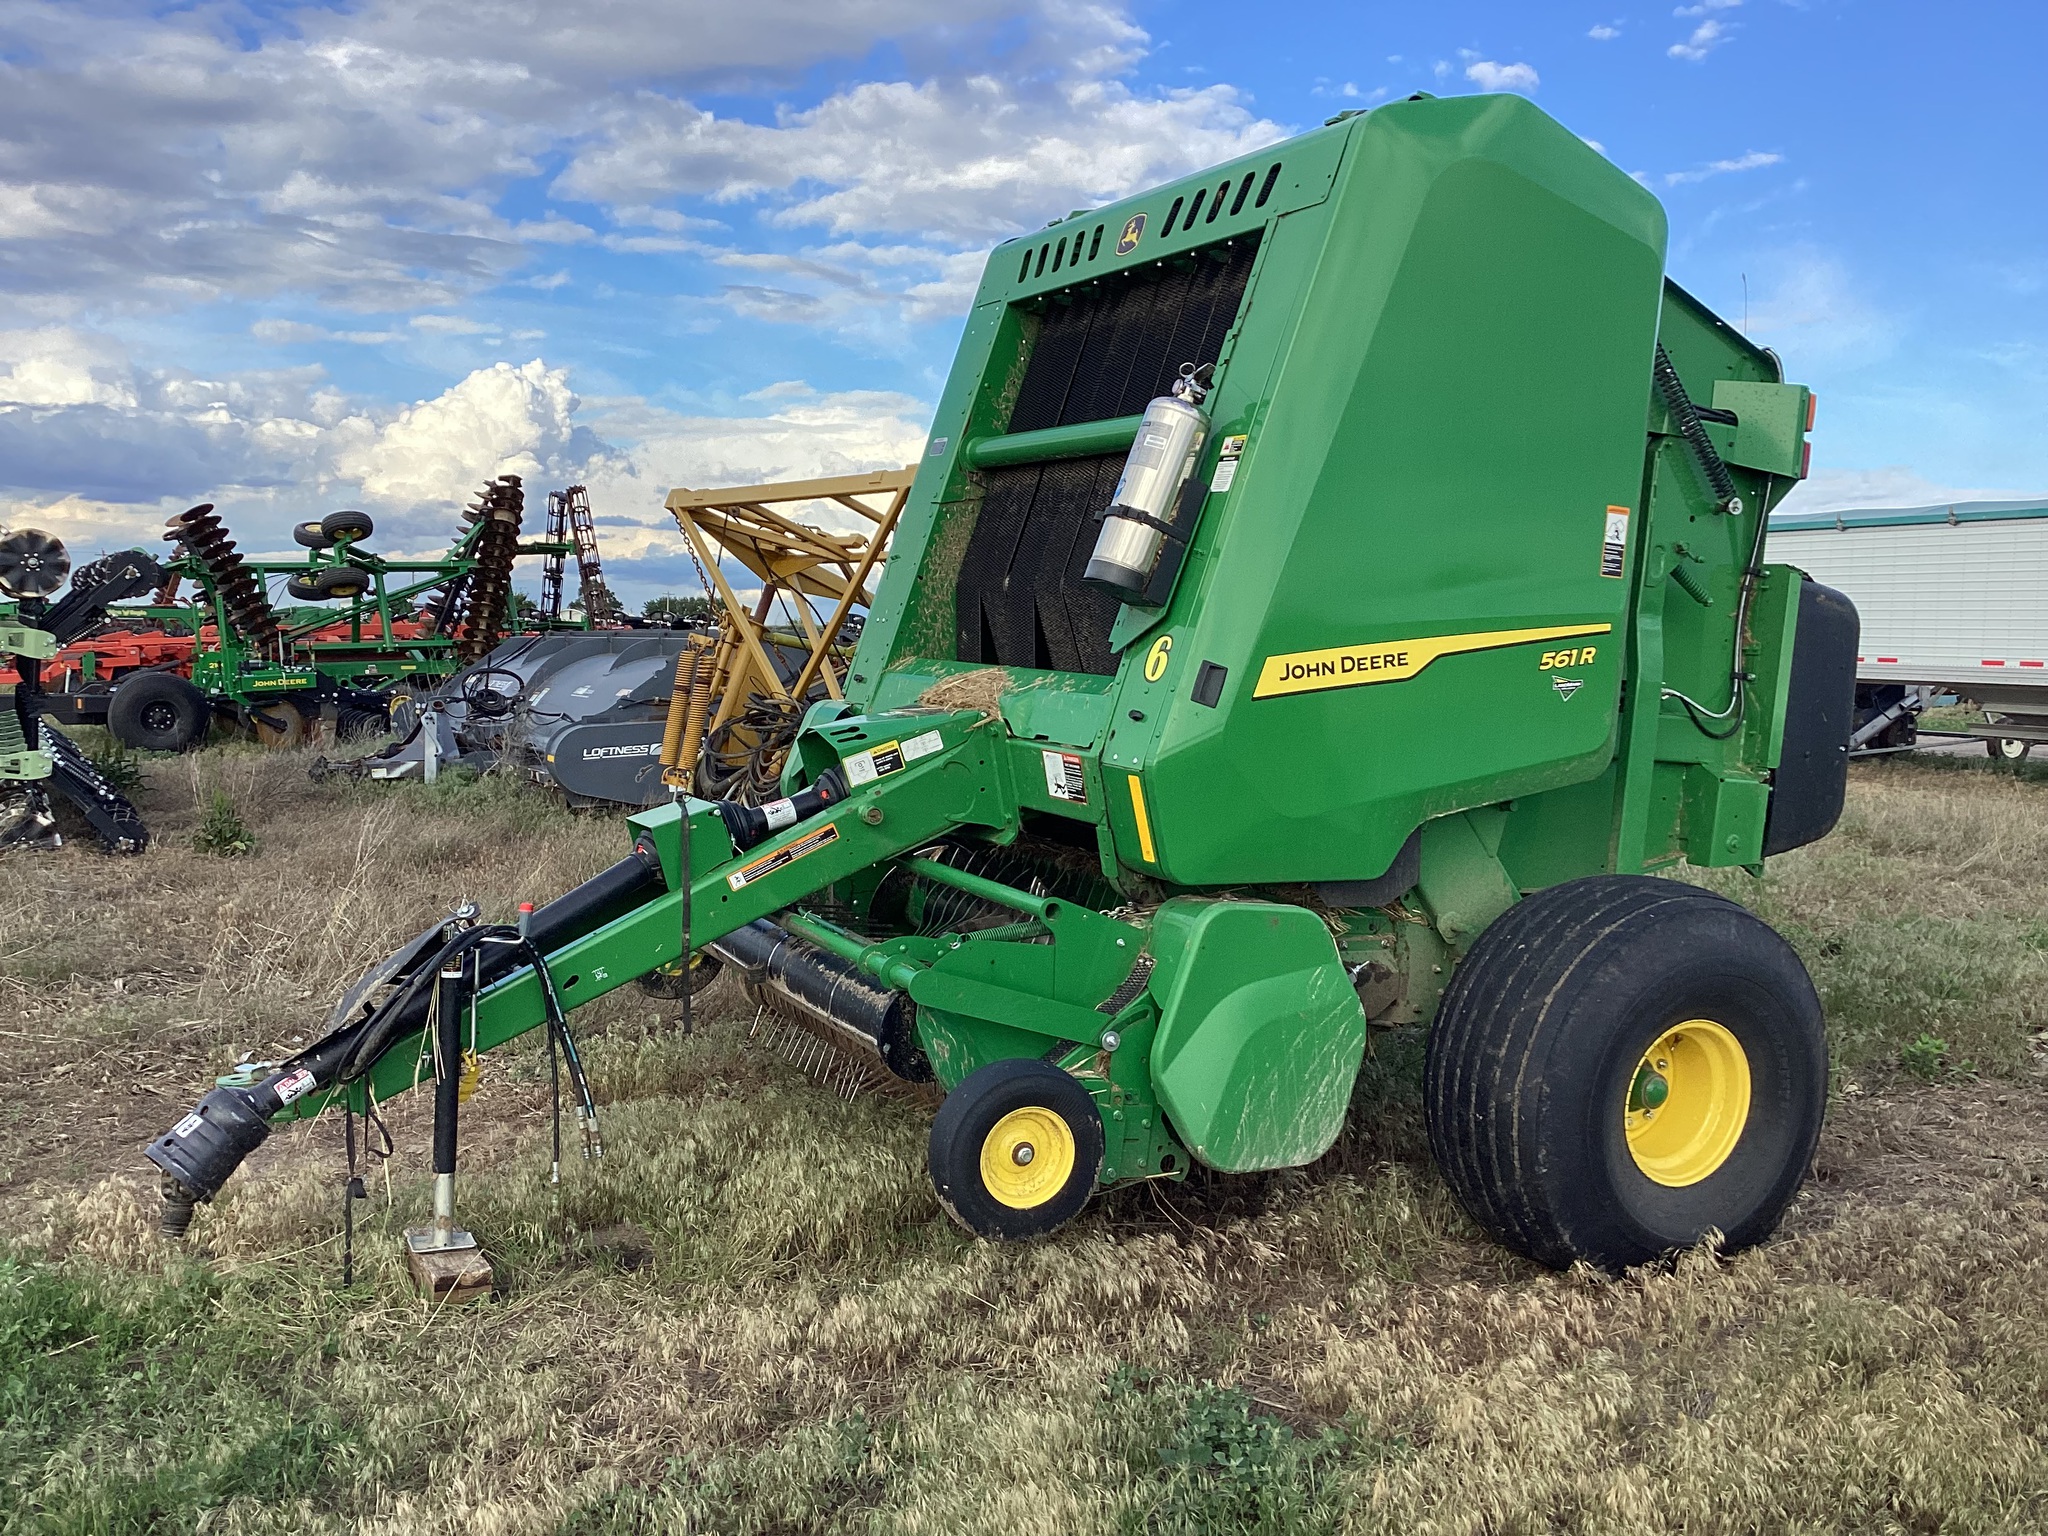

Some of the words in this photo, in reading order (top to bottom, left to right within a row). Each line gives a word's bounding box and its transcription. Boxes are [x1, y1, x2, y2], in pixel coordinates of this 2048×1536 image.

[1144, 634, 1173, 683] 6
[1279, 661, 1335, 681] JOHN
[1341, 652, 1409, 673] DEERE
[1538, 646, 1597, 671] 561R
[252, 680, 276, 688] JOHN
[277, 678, 308, 687] DEERE
[582, 744, 650, 757] LOFTNESS
